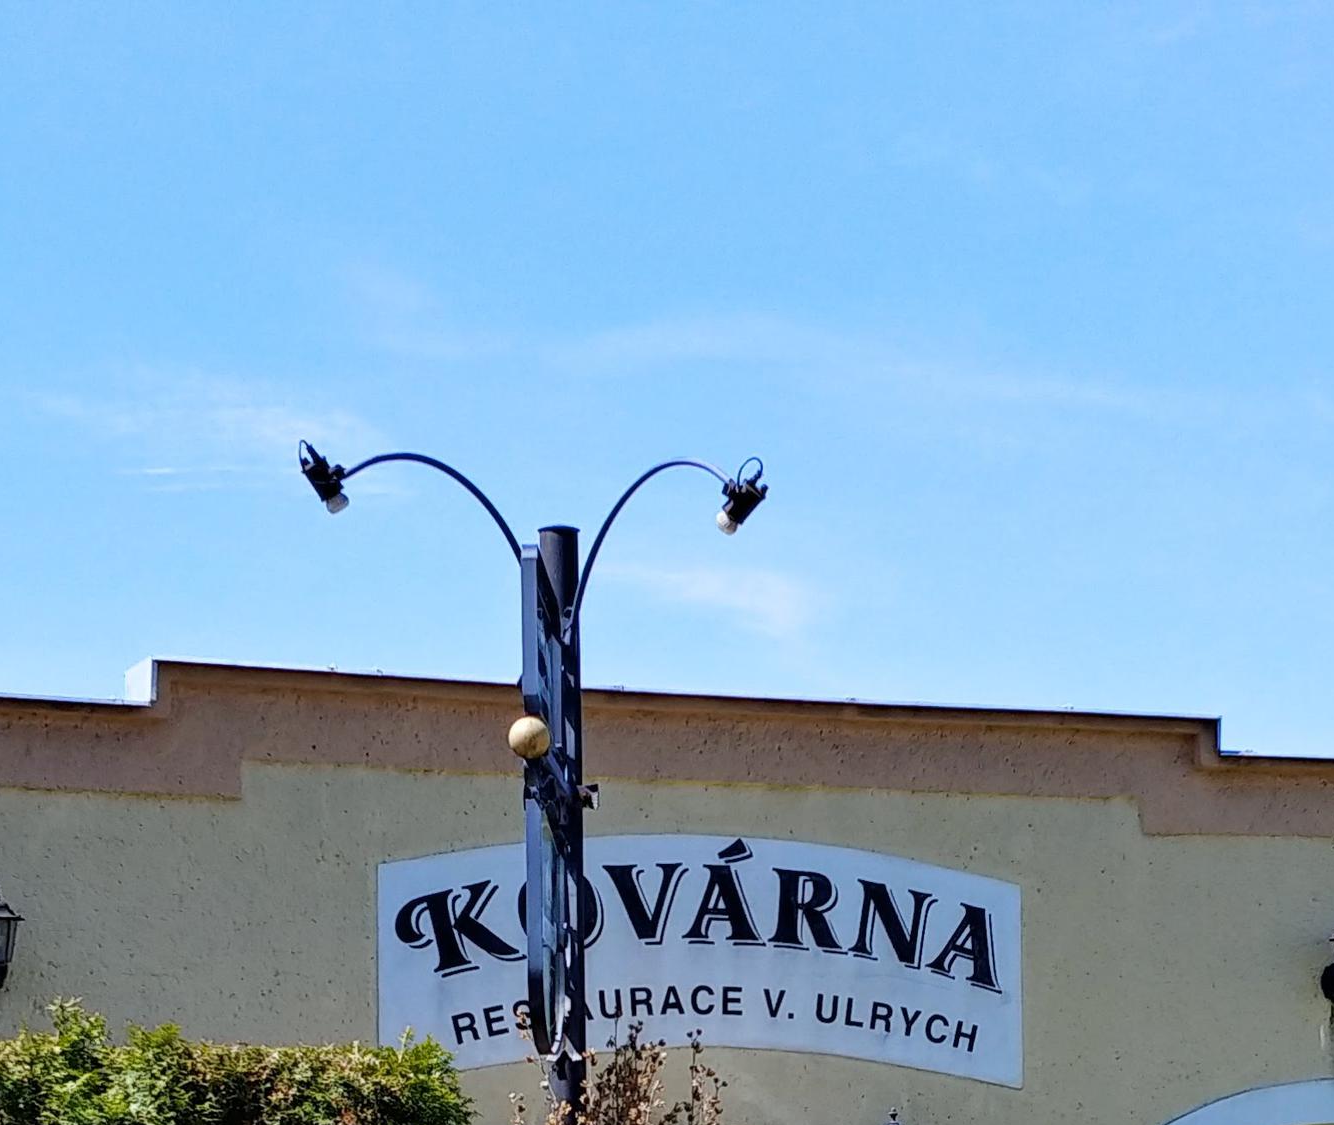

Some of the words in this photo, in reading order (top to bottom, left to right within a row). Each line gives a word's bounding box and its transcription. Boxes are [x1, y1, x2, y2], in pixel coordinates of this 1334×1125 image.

[451, 985, 743, 1045] RESURACE
[763, 989, 794, 1020] V.
[815, 993, 979, 1053] ULRYCH
